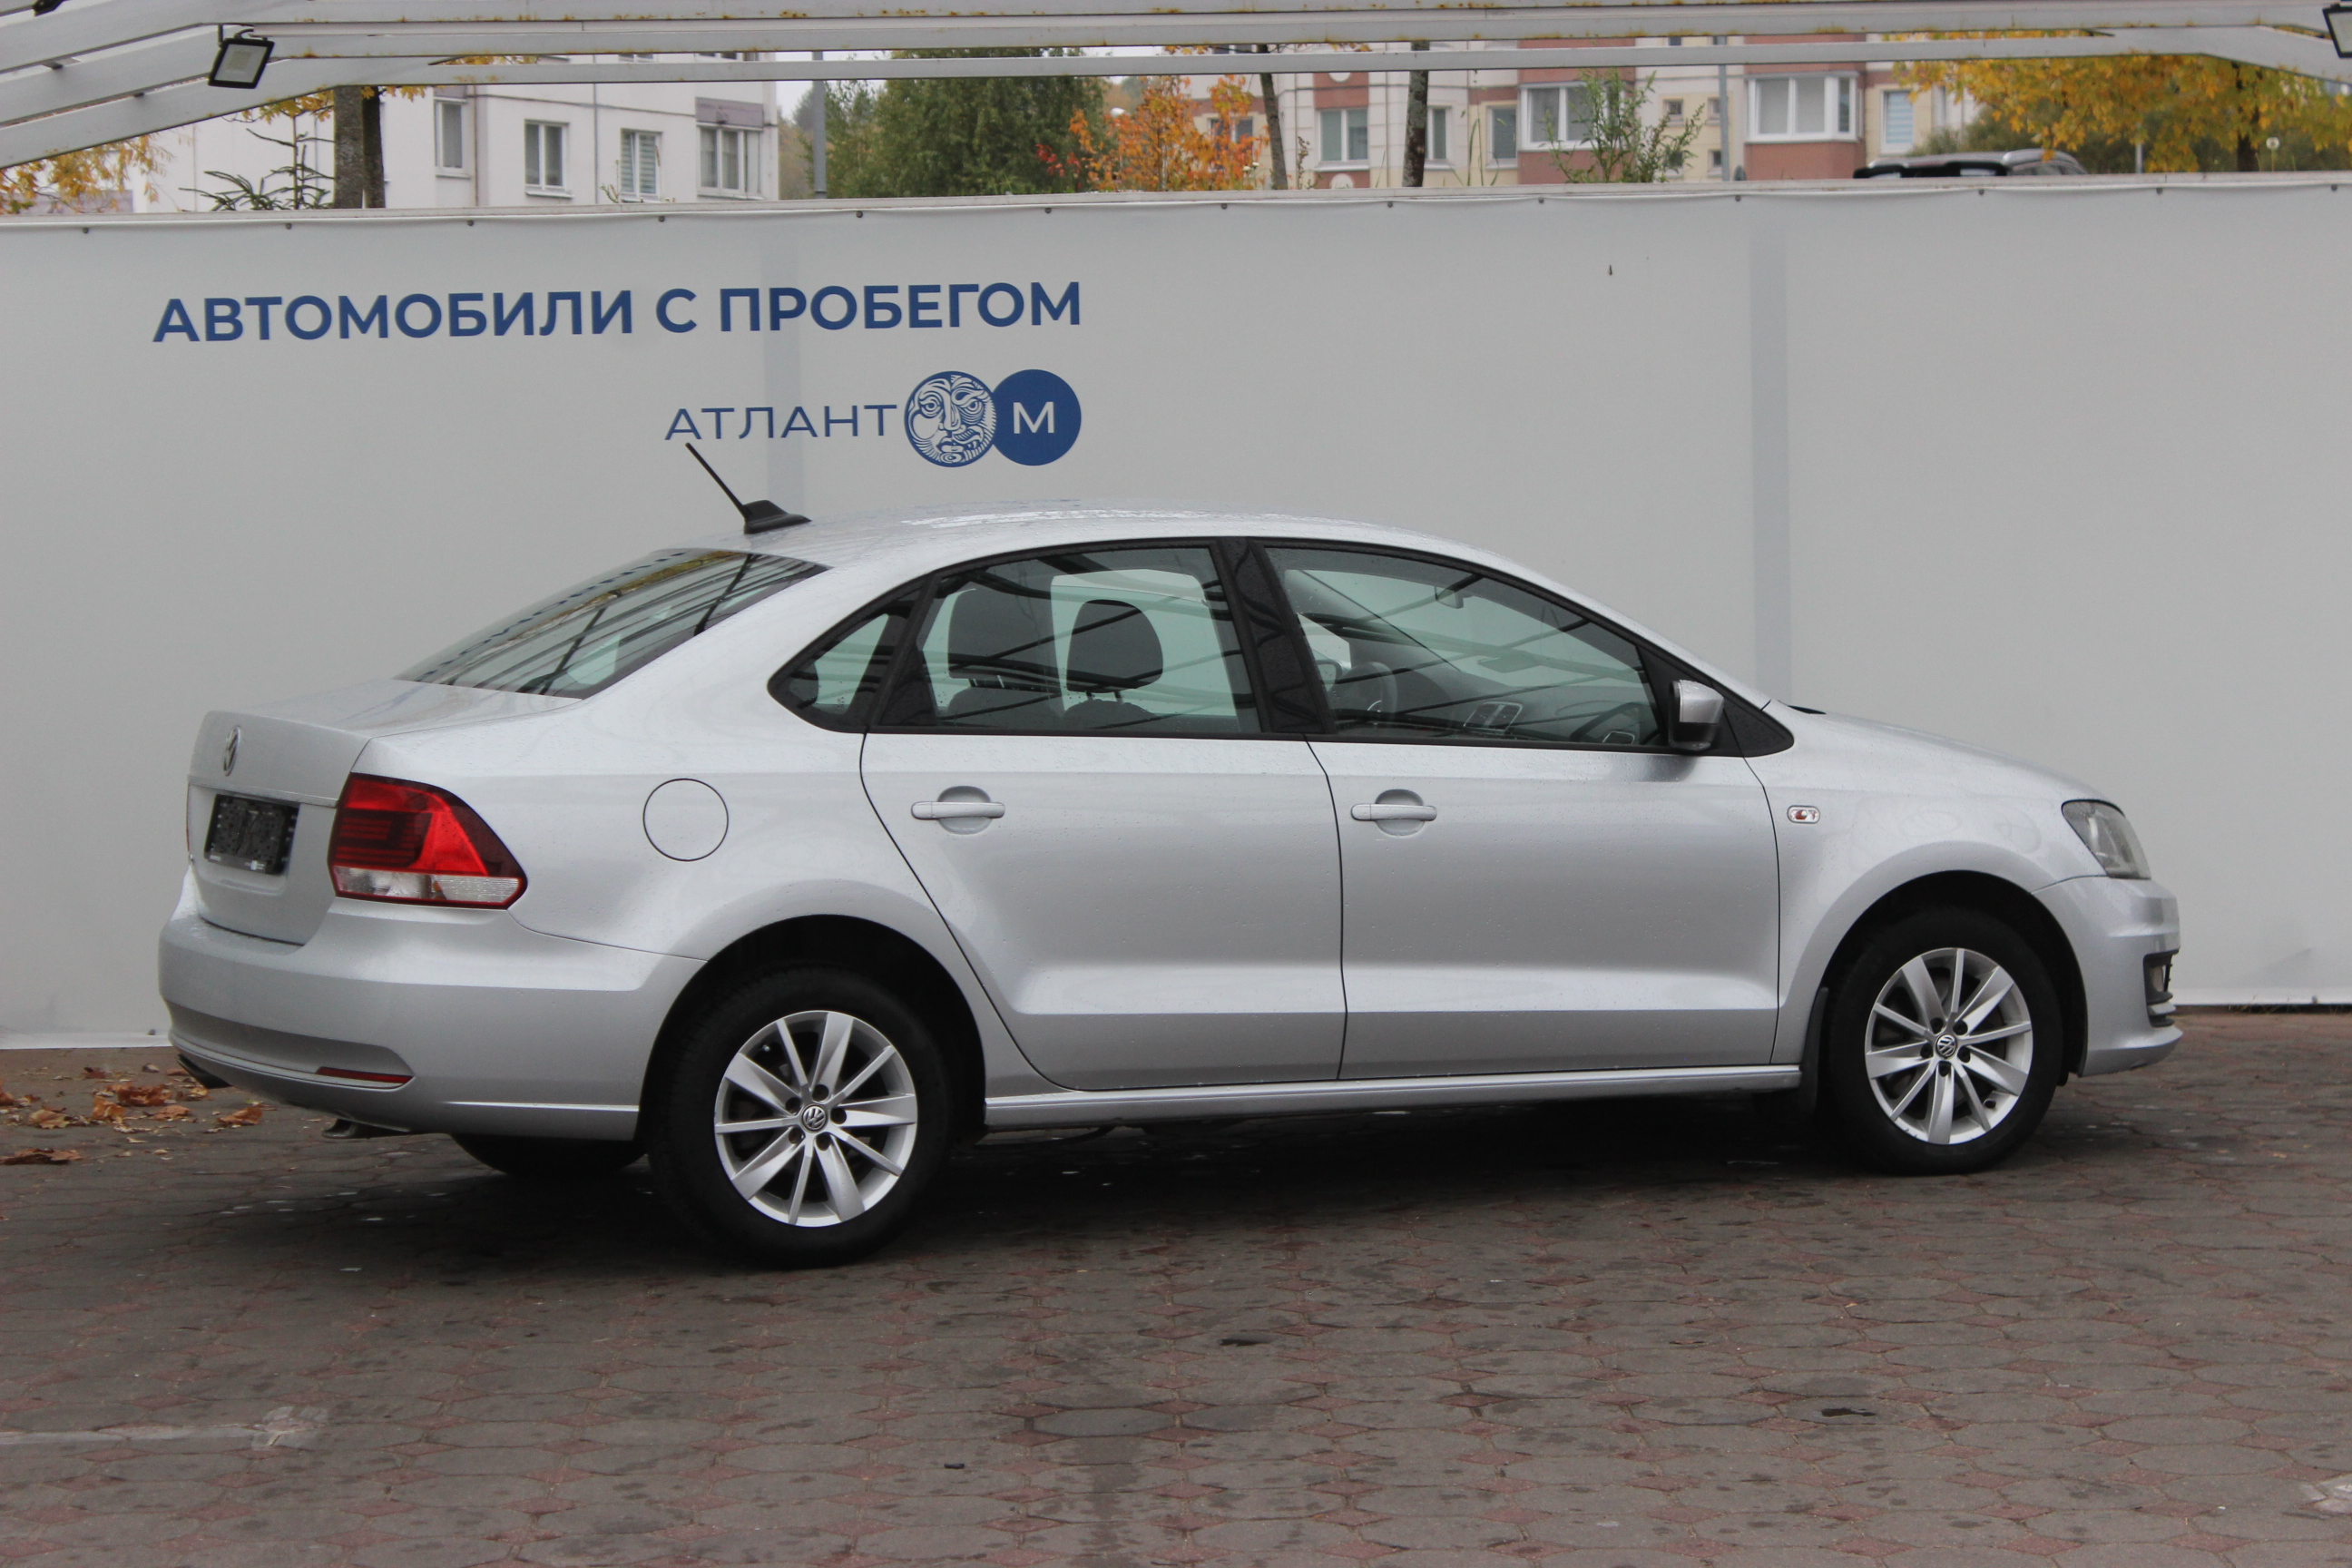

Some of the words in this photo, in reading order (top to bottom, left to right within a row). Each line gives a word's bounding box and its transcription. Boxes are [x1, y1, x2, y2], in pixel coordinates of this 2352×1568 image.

[155, 290, 633, 342] АВТОМОБИЛИ
[658, 289, 697, 333] С
[721, 282, 1081, 332] ПРОБЕГОМ
[664, 404, 898, 440] АТЛАНТ
